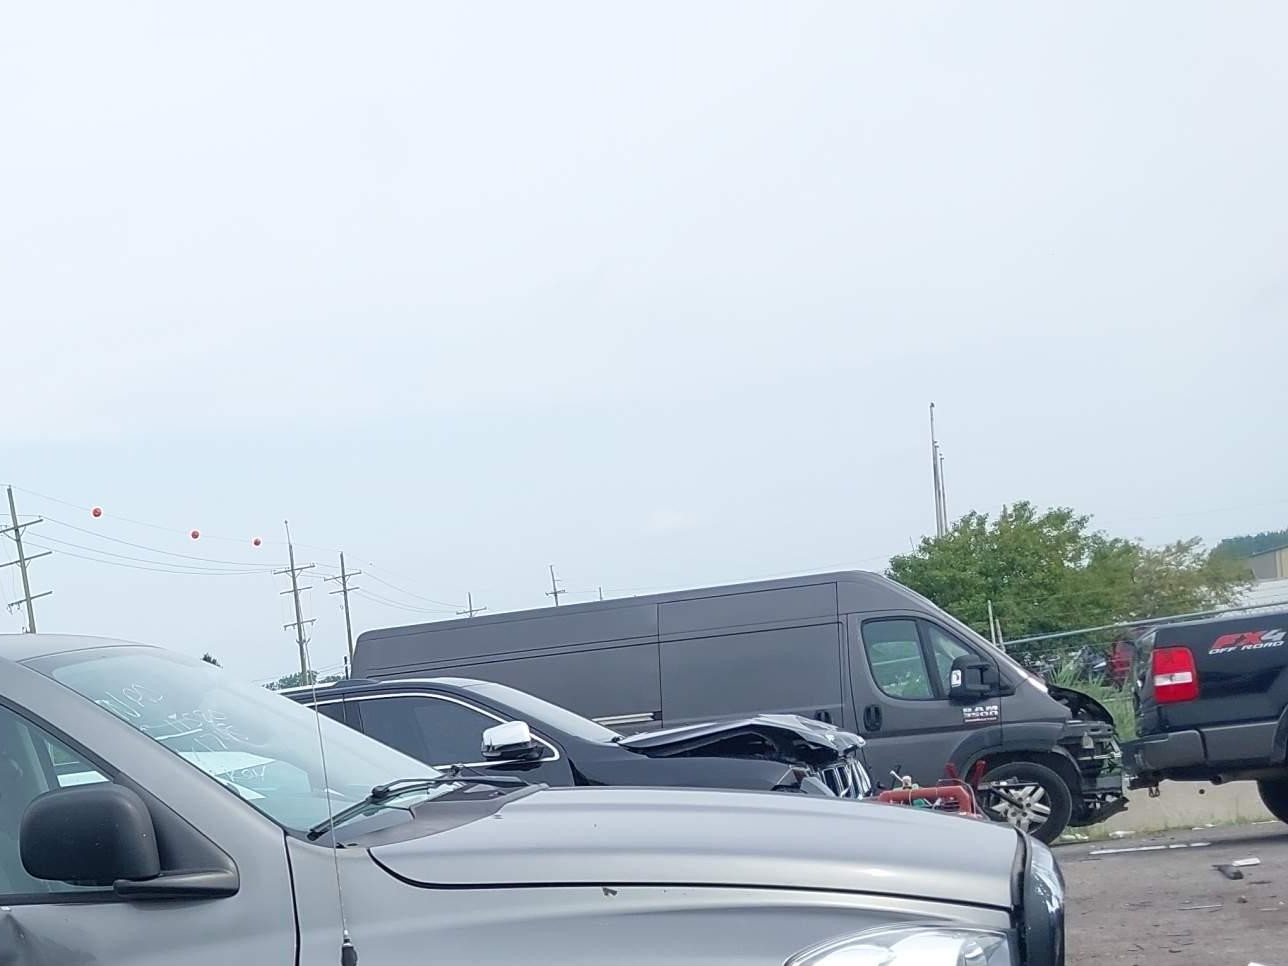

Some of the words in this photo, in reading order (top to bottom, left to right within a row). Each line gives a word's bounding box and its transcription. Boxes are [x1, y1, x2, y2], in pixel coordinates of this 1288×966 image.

[1208, 646, 1238, 655] OFF
[1240, 640, 1285, 651] ROAD
[1212, 628, 1287, 649] FX4
